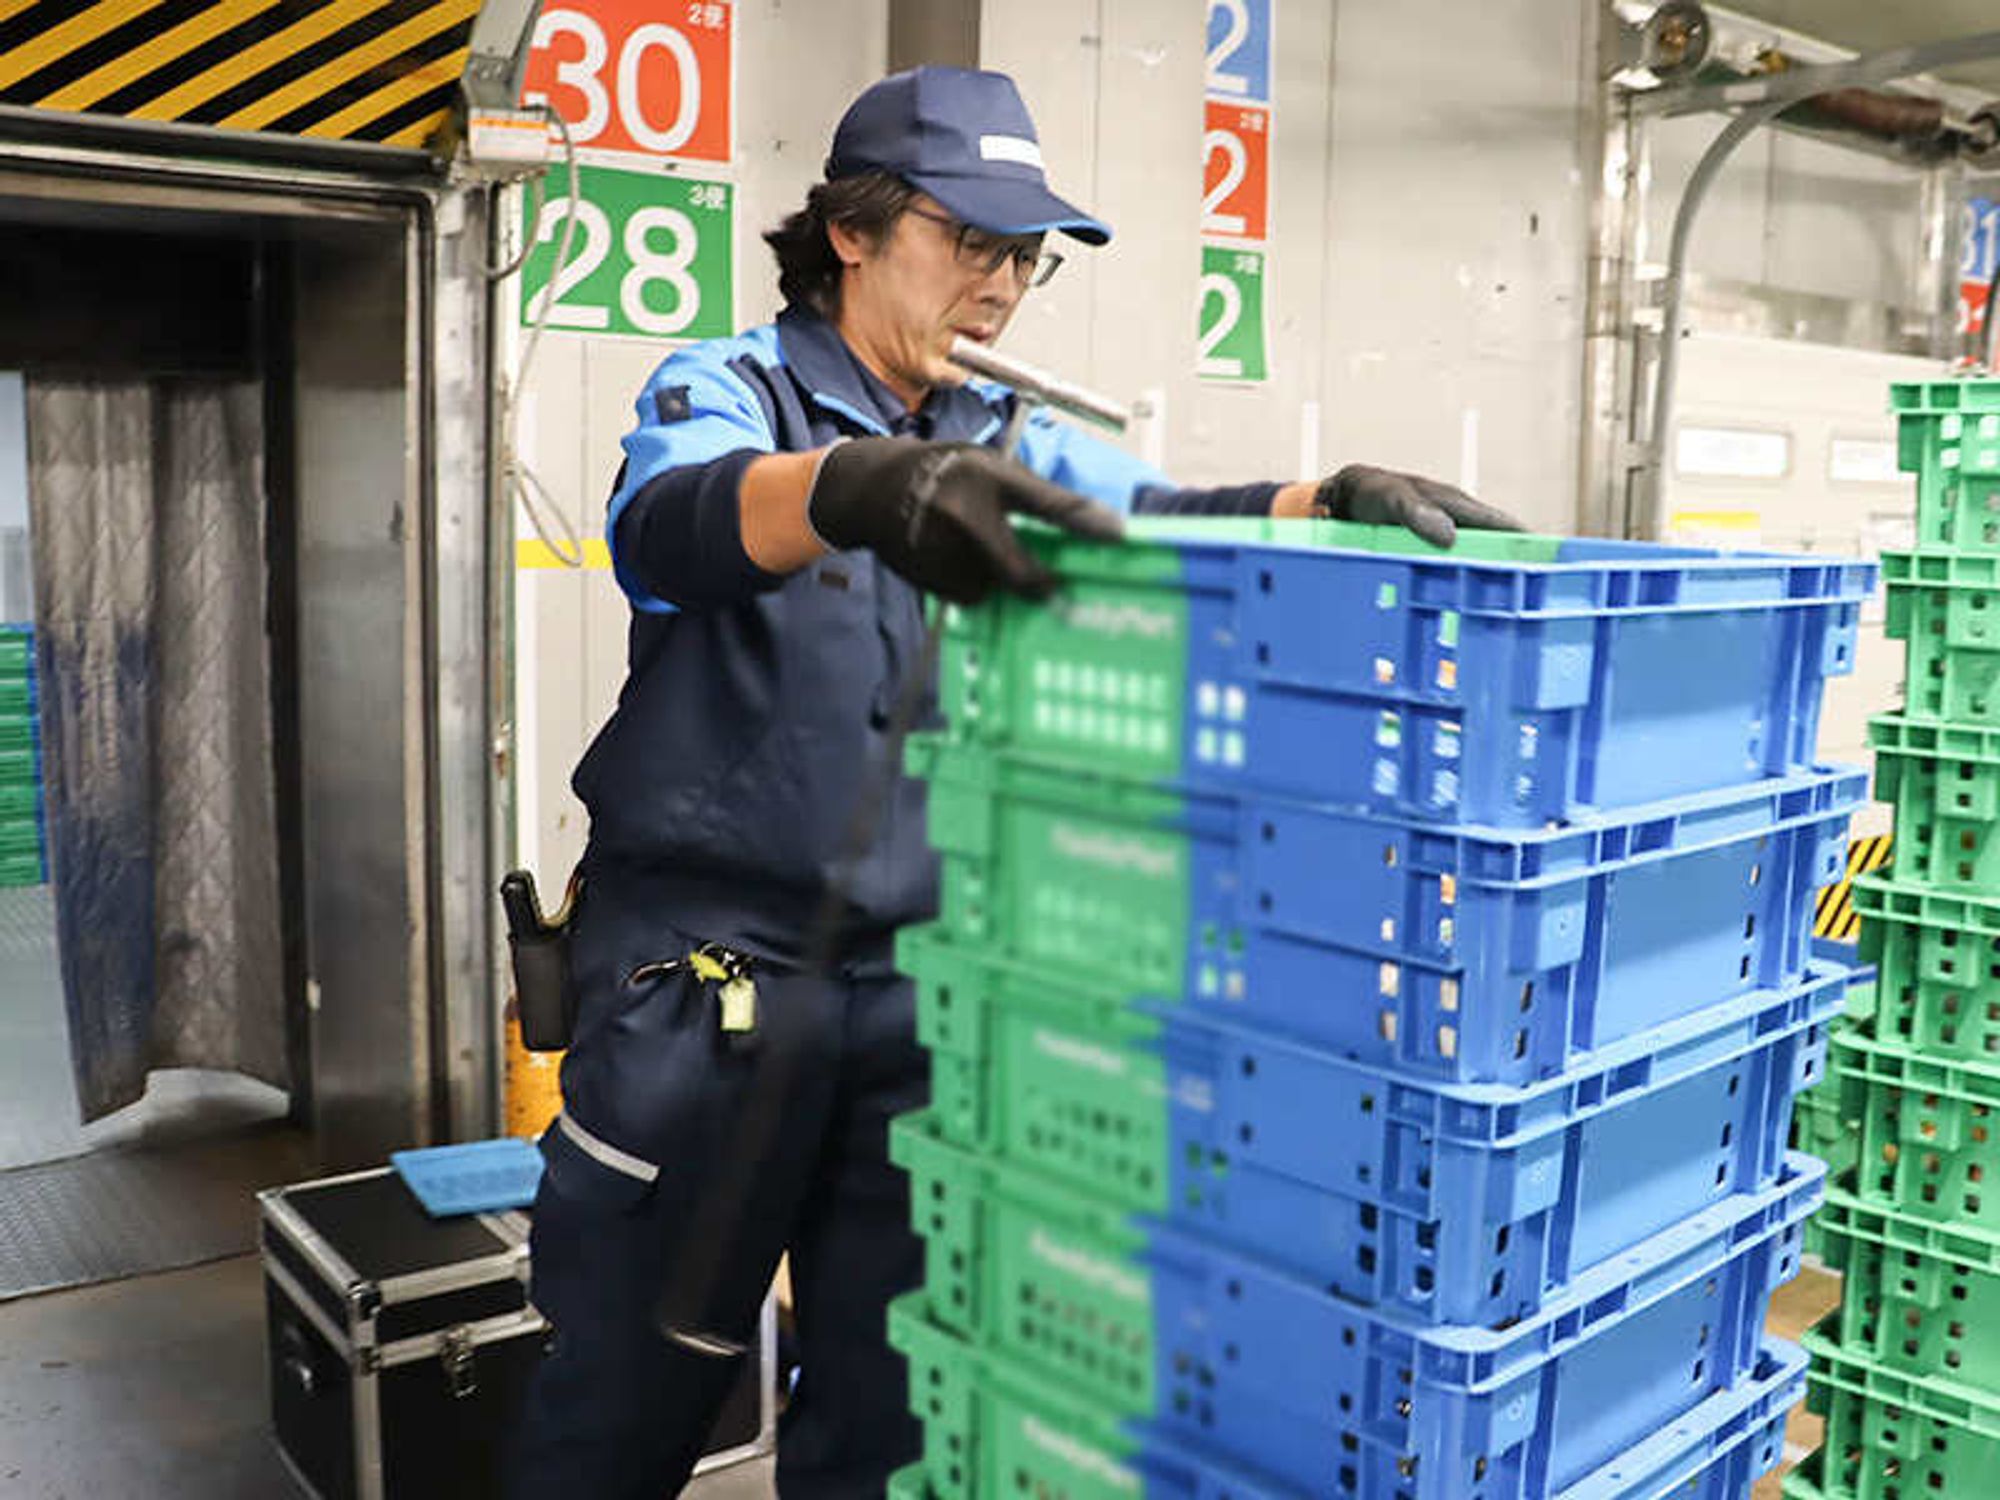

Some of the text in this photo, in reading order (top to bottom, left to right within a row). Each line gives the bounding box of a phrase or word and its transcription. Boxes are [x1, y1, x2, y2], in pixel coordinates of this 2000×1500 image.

[524, 8, 701, 153] 30
[1201, 129, 1247, 234] 2
[526, 197, 700, 334] 28
[1197, 273, 1242, 377] 2
